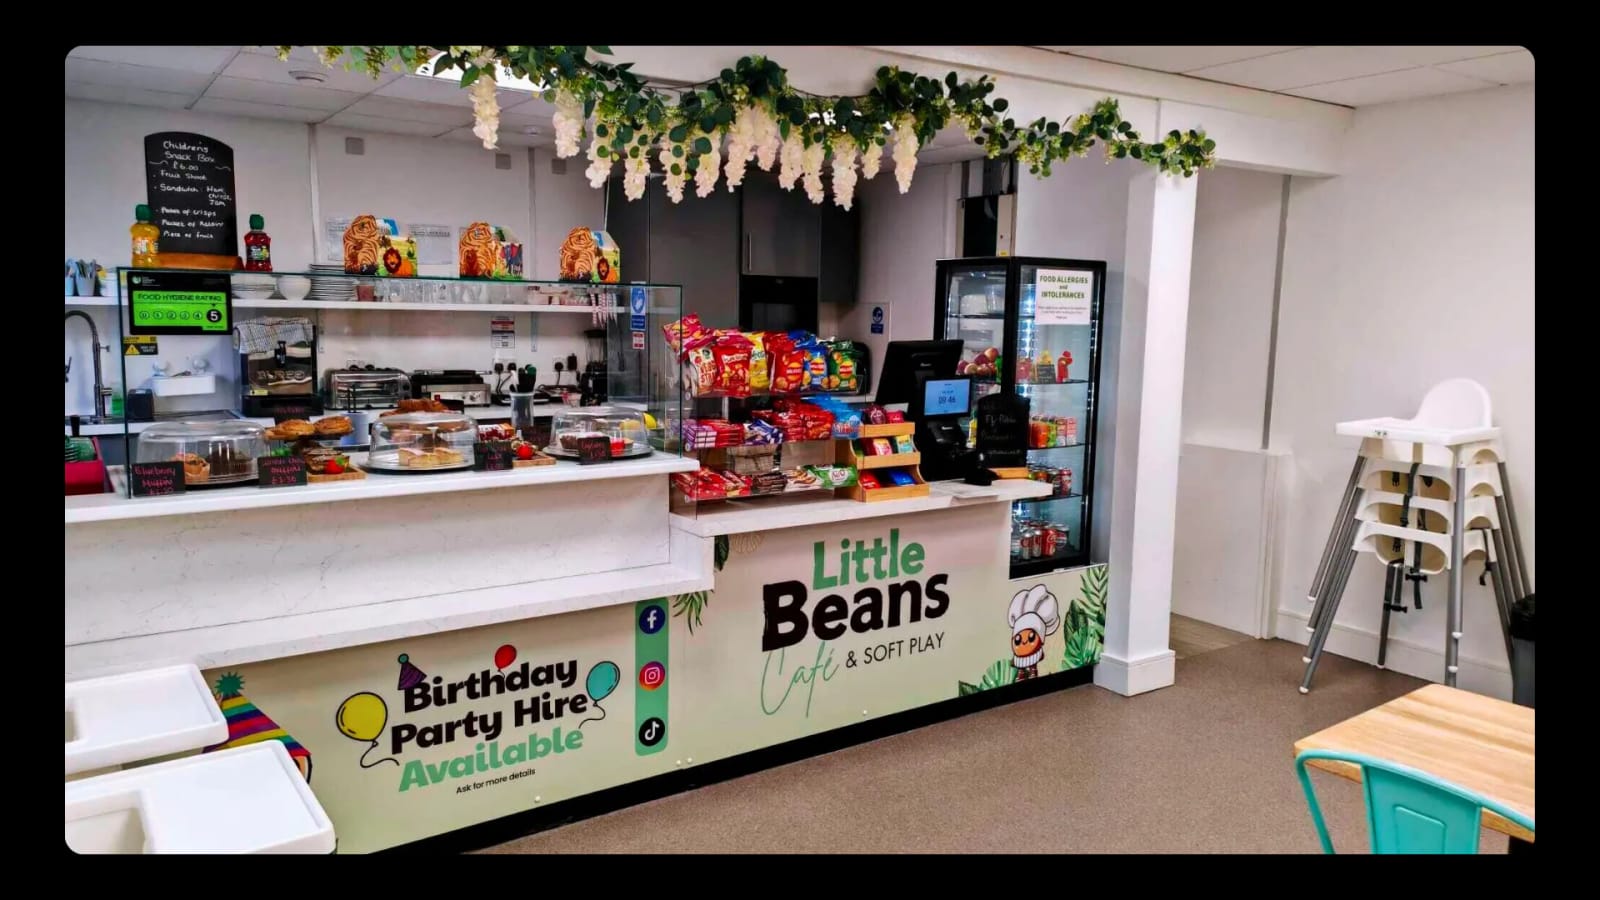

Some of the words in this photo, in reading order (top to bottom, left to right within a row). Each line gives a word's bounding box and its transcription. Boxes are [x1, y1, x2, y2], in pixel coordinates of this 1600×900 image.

[160, 169, 180, 179] Fruit
[165, 151, 191, 162] Snack
[198, 154, 214, 162] Box
[160, 183, 199, 192] Sandwich
[182, 206, 191, 215] of
[210, 311, 218, 321] 5
[813, 528, 925, 590] Little
[762, 573, 950, 652] Beans
[404, 660, 577, 713] Birthday
[761, 640, 839, 718] Café
[846, 651, 857, 668] &
[864, 640, 904, 664] SOFT
[910, 632, 945, 654] PLAY
[392, 710, 503, 755] Party
[514, 692, 588, 728] Hire
[399, 726, 584, 792] Available
[456, 784, 472, 794] Ask
[473, 780, 484, 791] for
[485, 775, 507, 787] more
[509, 768, 536, 781] details
